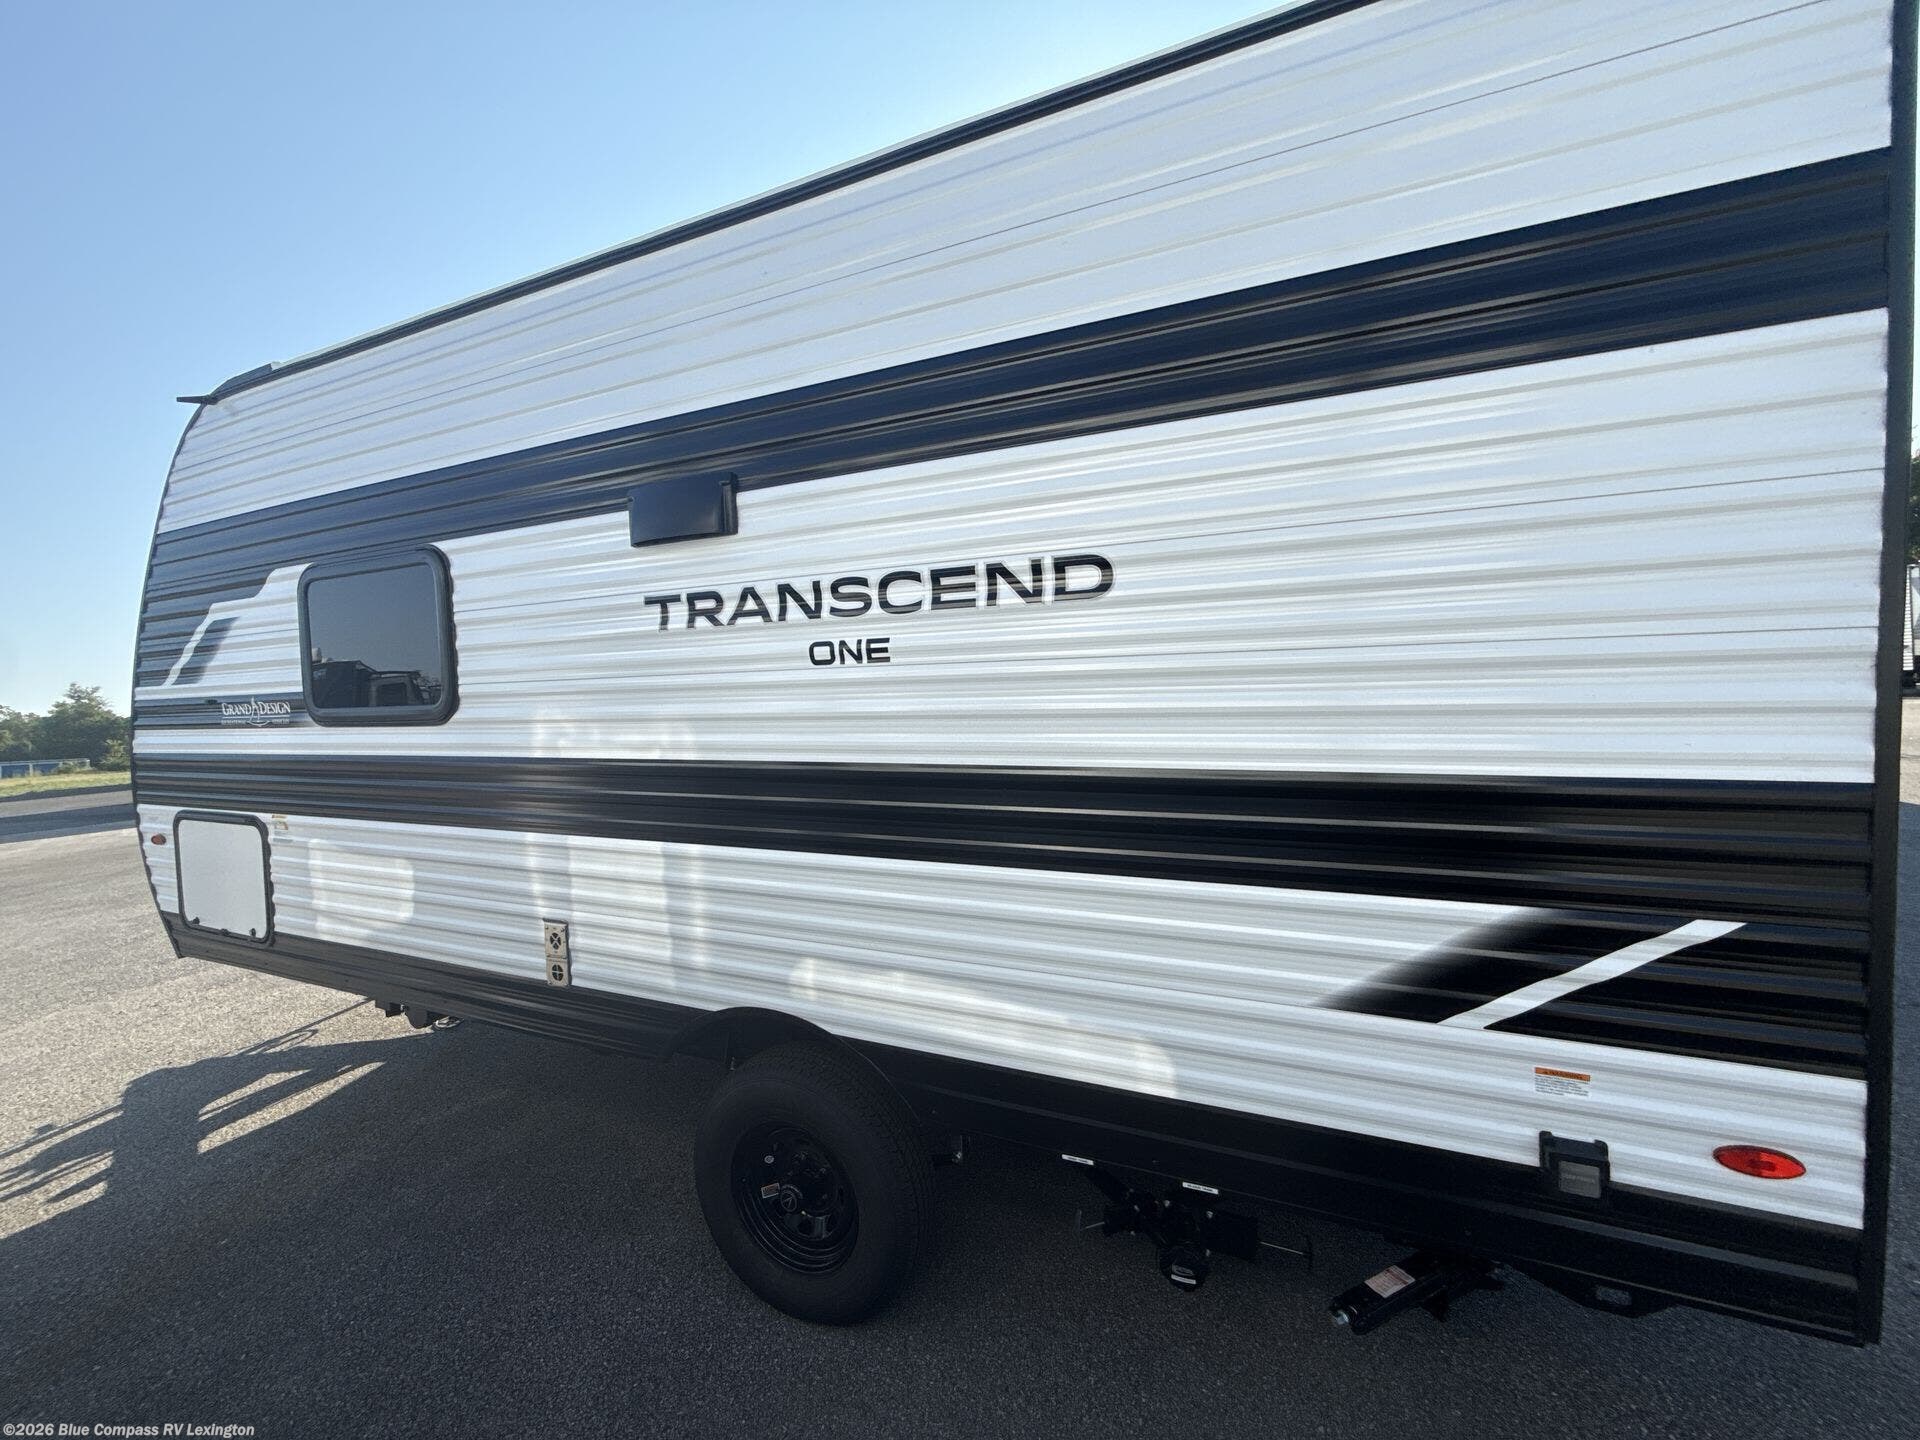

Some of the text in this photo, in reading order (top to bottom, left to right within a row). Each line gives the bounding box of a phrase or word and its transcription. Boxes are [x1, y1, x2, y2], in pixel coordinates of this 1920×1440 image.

[643, 553, 1115, 632] TRANSCEND
[808, 637, 891, 666] ONE
[221, 701, 291, 716] GRAND DESIGN
